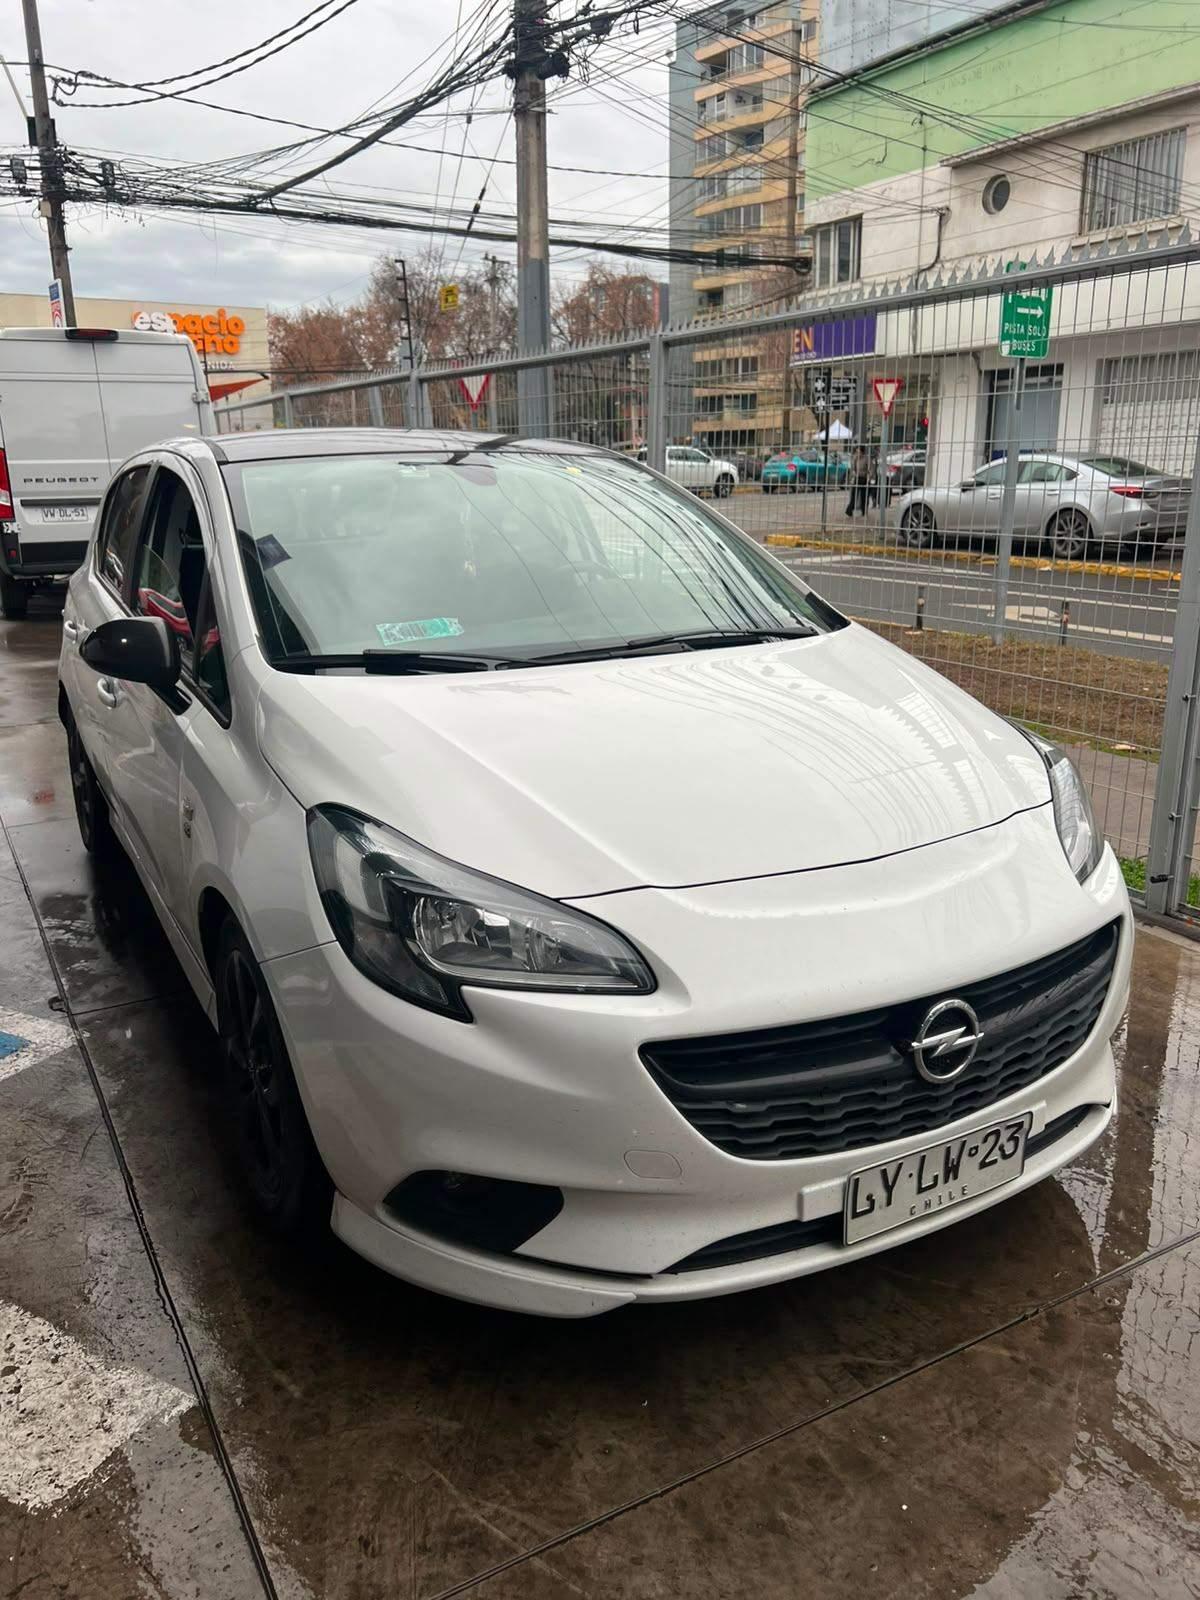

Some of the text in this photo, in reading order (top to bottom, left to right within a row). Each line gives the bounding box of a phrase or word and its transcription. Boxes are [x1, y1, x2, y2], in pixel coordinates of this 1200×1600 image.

[131, 308, 245, 336] espacio
[1003, 322, 1047, 337] PISTA SOLO
[1011, 339, 1036, 352] BUSES
[909, 1184, 969, 1217] CHILE
